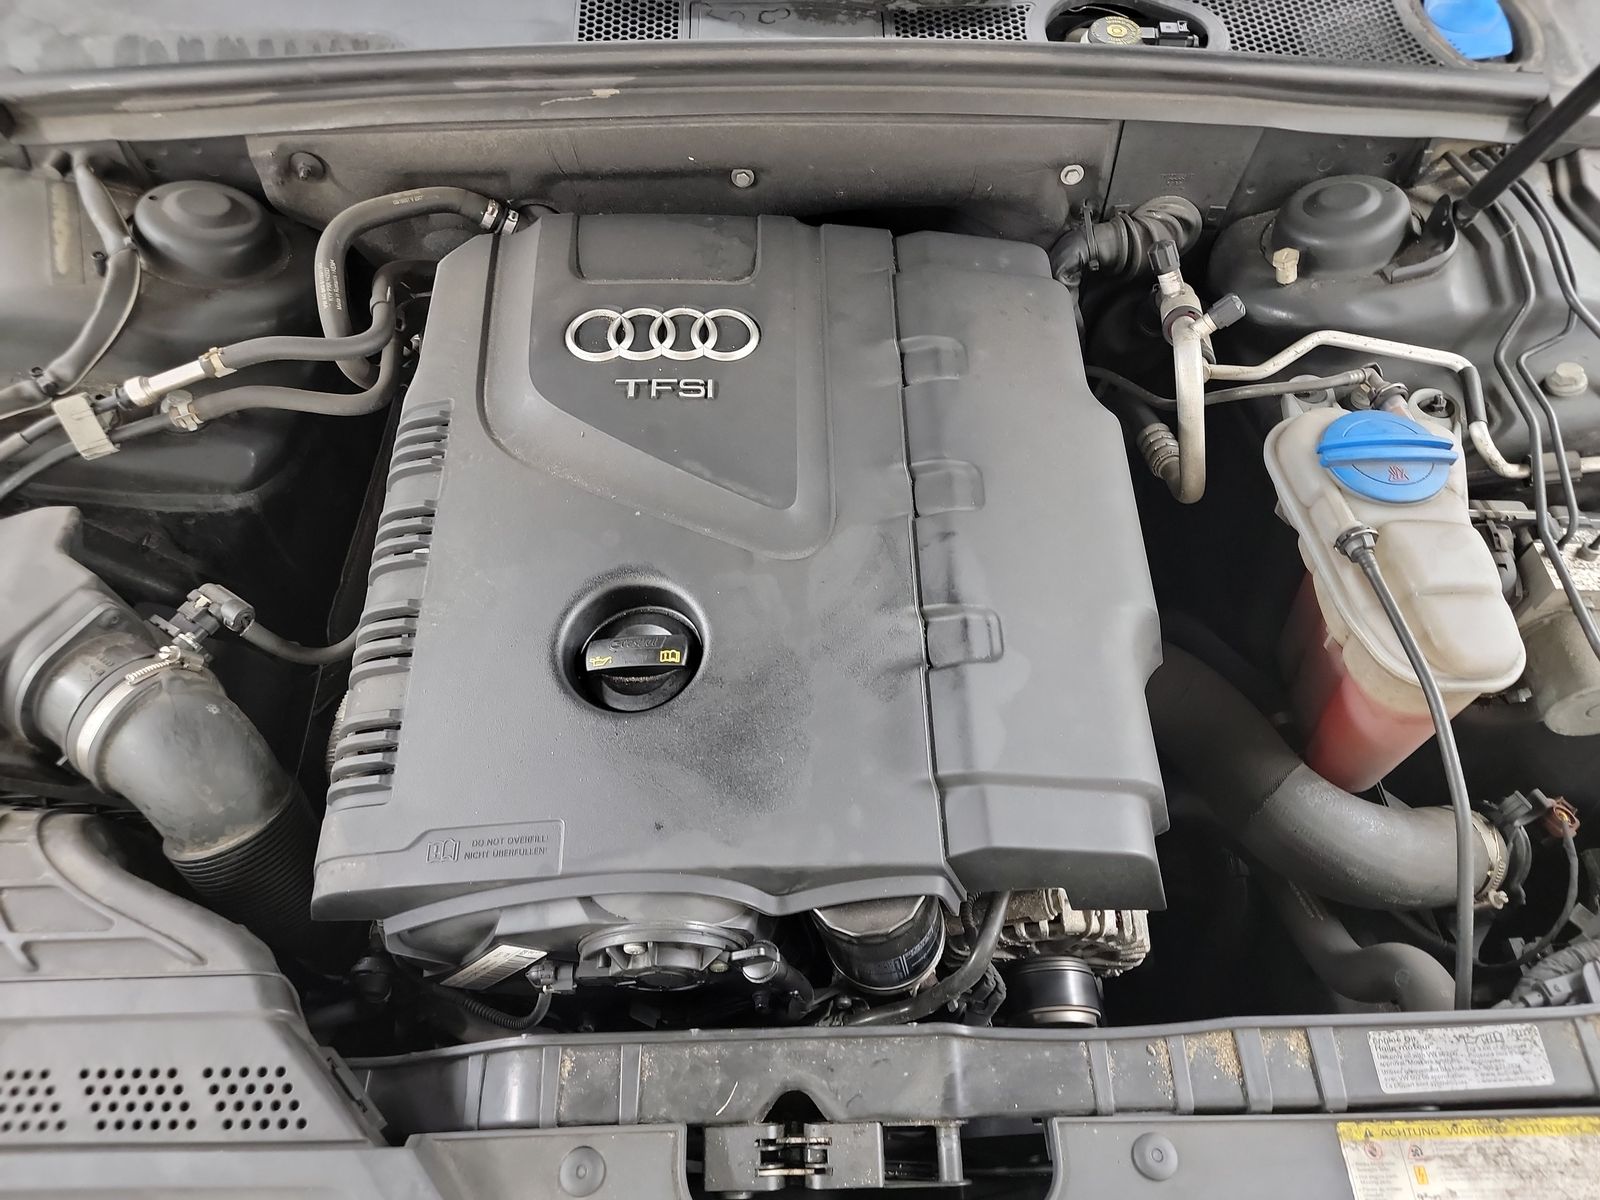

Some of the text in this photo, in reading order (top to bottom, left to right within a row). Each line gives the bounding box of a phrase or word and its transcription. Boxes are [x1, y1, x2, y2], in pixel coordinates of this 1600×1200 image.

[614, 378, 714, 399] TFSI
[472, 839, 485, 848] DO
[487, 837, 504, 846] NOT
[464, 850, 489, 860] NICHT
[1380, 1126, 1441, 1137] ACHTUNG
